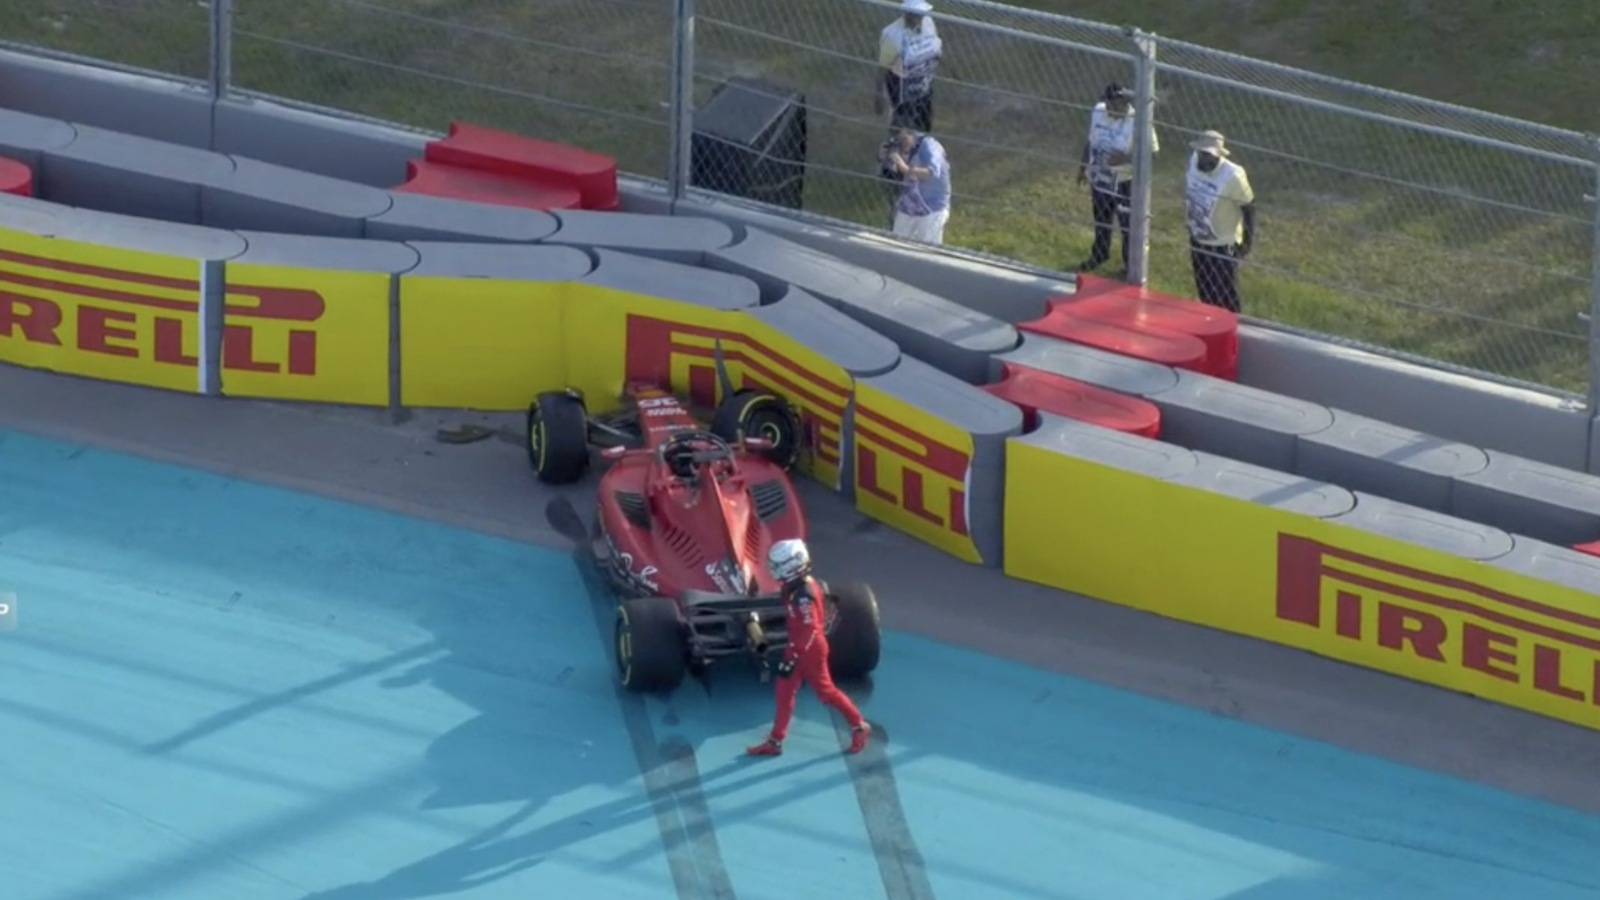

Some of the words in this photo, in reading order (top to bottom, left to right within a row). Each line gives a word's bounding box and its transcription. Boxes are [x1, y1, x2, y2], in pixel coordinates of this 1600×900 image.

[0, 249, 325, 375] RELLI
[626, 313, 968, 536] PIELLI
[1276, 531, 1600, 706] PIREL
